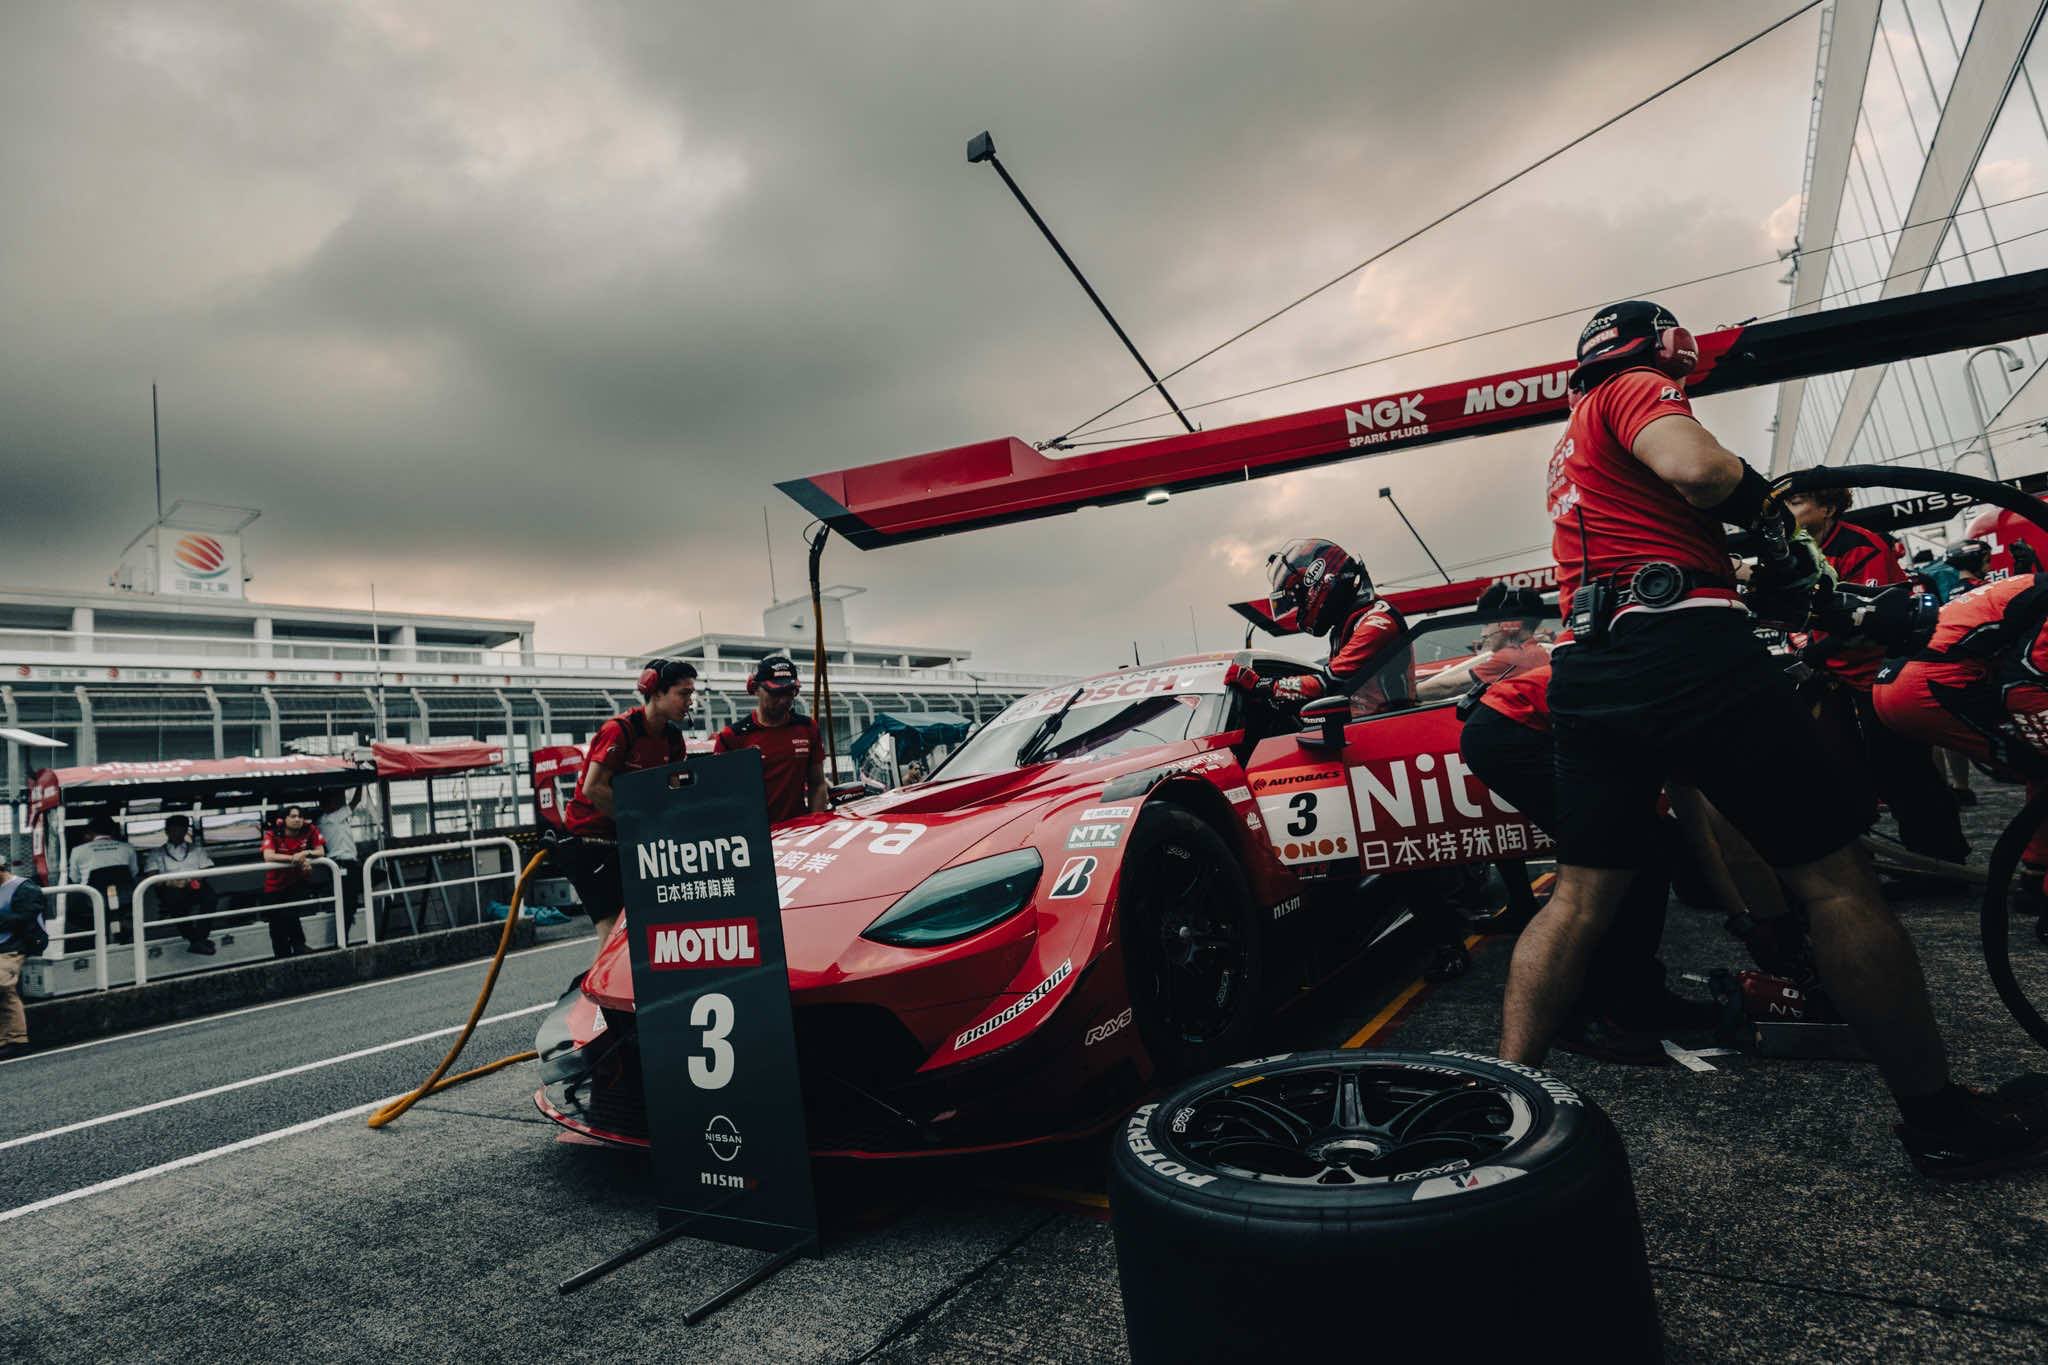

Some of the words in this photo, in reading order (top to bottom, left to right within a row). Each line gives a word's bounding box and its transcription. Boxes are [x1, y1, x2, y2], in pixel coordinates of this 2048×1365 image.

[1464, 370, 1572, 415] MOTU
[1345, 393, 1427, 434] NGK
[1350, 432, 1387, 447] SPARK
[1390, 424, 1429, 442] PLUGS
[1892, 493, 1979, 518] NISS
[1268, 771, 1341, 787] AUTOBACS
[1349, 752, 1520, 833] Nit
[1069, 824, 1121, 842] NTK
[1287, 792, 1318, 837] 3
[771, 820, 928, 855] erra
[637, 835, 751, 880] Niterra
[774, 850, 840, 874] 陶業
[656, 877, 736, 904] 日本特殊陶業
[654, 925, 755, 964] MOTUL
[954, 958, 1074, 1050] BRIDGESTONE
[688, 993, 735, 1089] 3
[1085, 1008, 1132, 1046] RAYS
[705, 1133, 742, 1144] NISSAN
[1127, 1103, 1219, 1188] POTENZA
